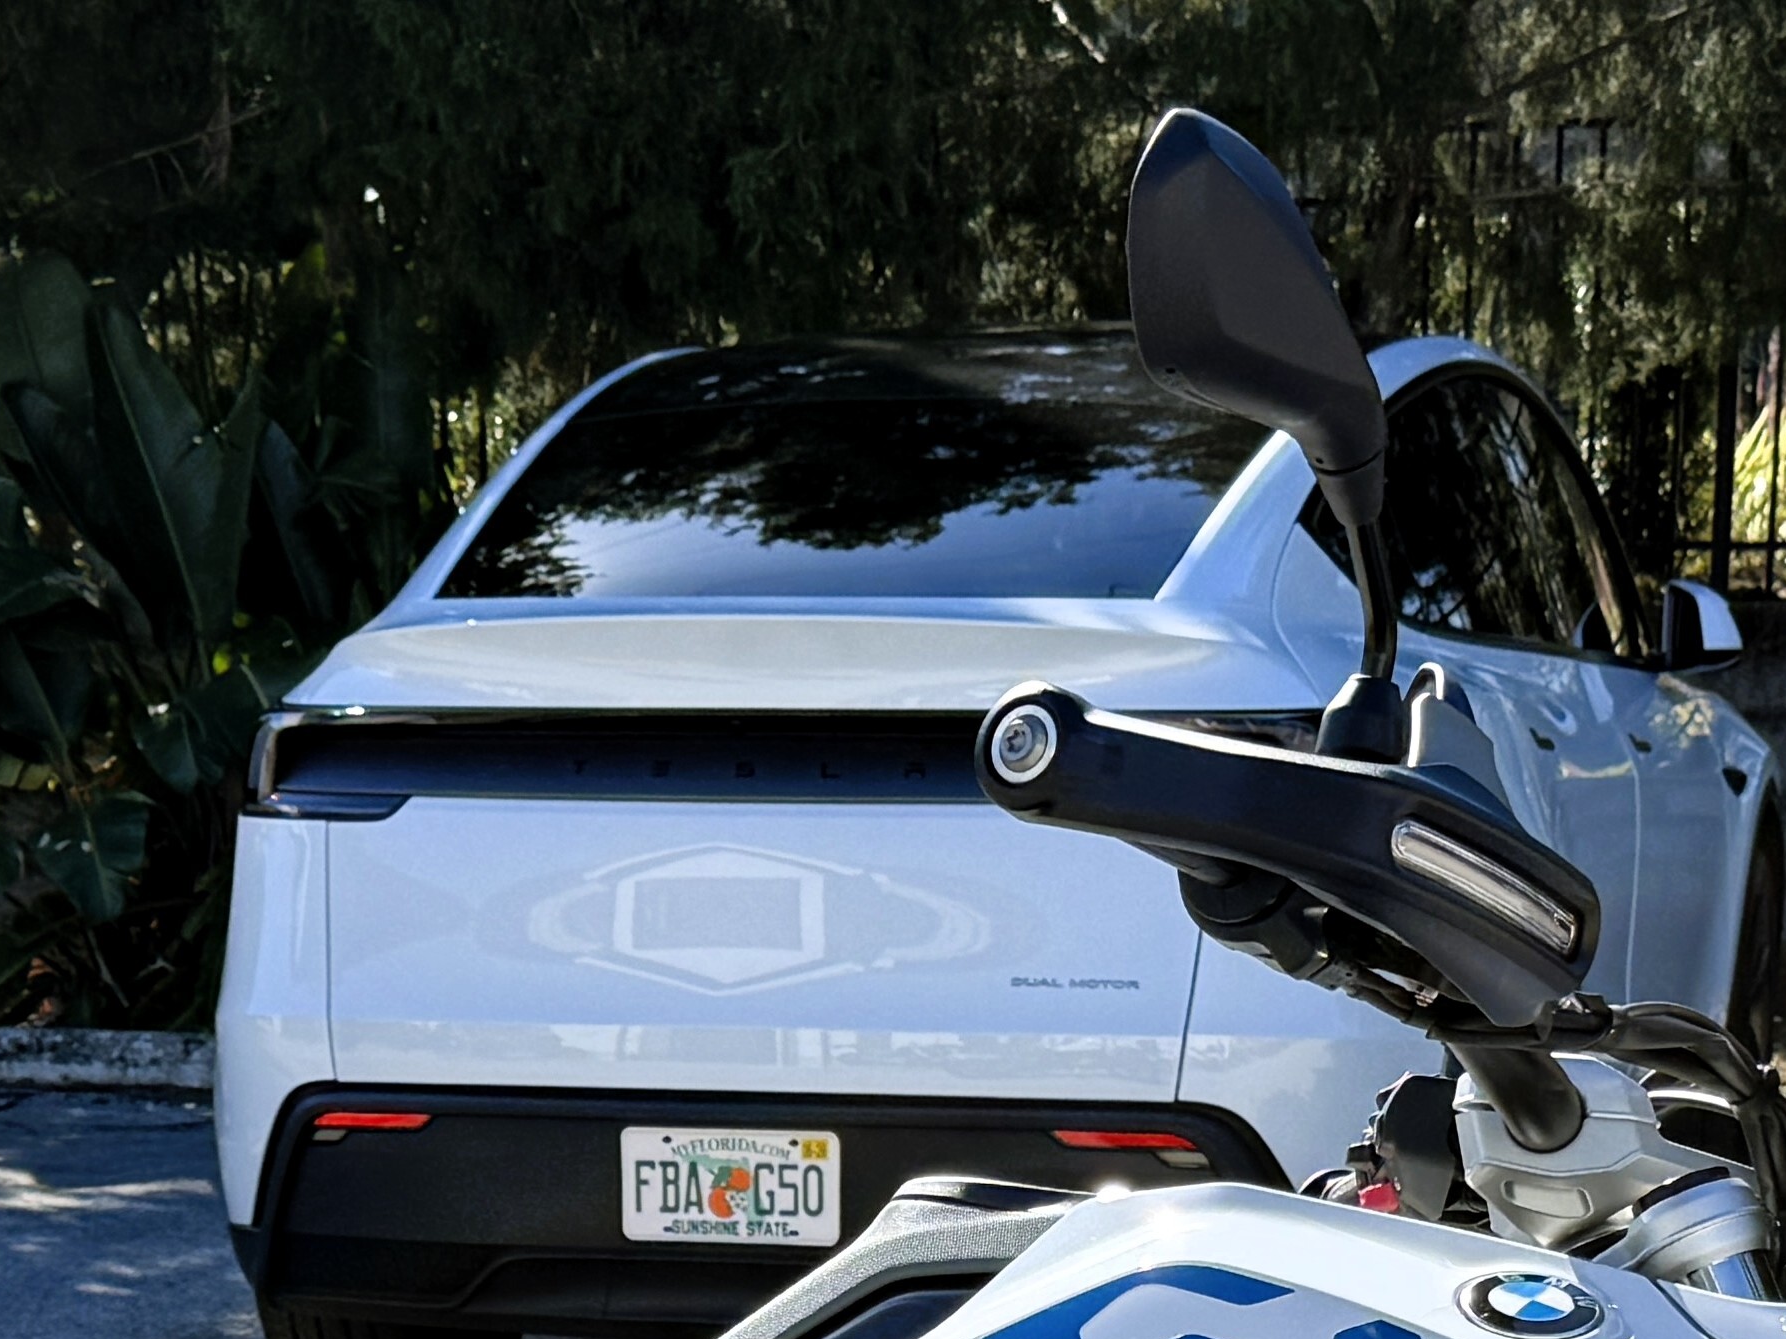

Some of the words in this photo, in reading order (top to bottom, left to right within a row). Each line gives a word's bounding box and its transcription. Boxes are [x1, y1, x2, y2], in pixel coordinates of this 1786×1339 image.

[569, 758, 927, 781] TESLA
[1010, 976, 1063, 988] DUAL
[1068, 978, 1140, 990] MOTOR
[671, 1137, 791, 1161] MYFLORIDA.COM
[635, 1159, 704, 1215] FBA
[753, 1162, 825, 1218] G50
[672, 1219, 740, 1237] SUNSHINE
[746, 1220, 791, 1238] STATE
